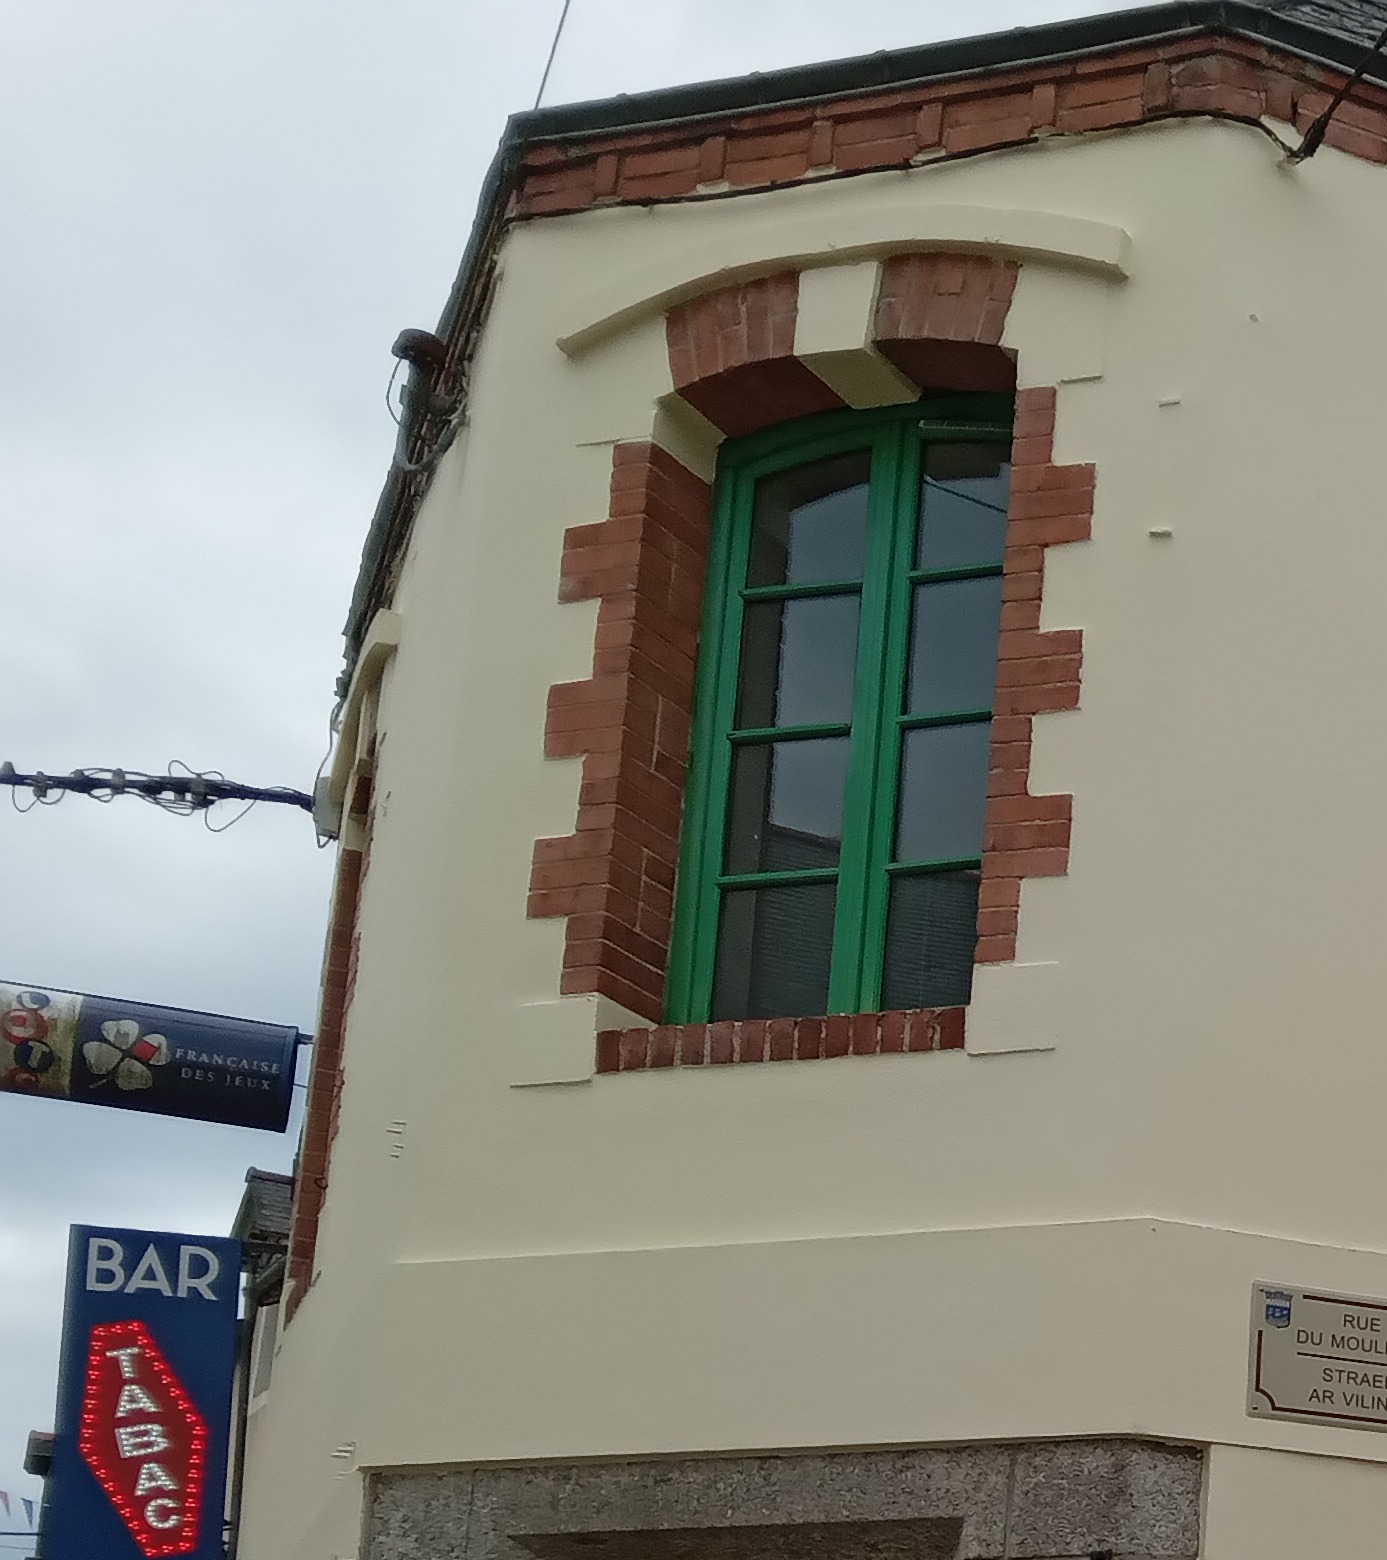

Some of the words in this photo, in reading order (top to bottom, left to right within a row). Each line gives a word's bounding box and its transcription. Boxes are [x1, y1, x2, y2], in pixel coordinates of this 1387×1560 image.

[175, 1048, 281, 1074] FRANÇAISE
[181, 1067, 215, 1082] DES
[225, 1074, 271, 1090] JEUX
[85, 1237, 219, 1301] BAR
[1343, 1314, 1381, 1333] RUE
[1296, 1329, 1323, 1346] DU
[1308, 1388, 1335, 1404] AR
[105, 1346, 182, 1530] TABAC
